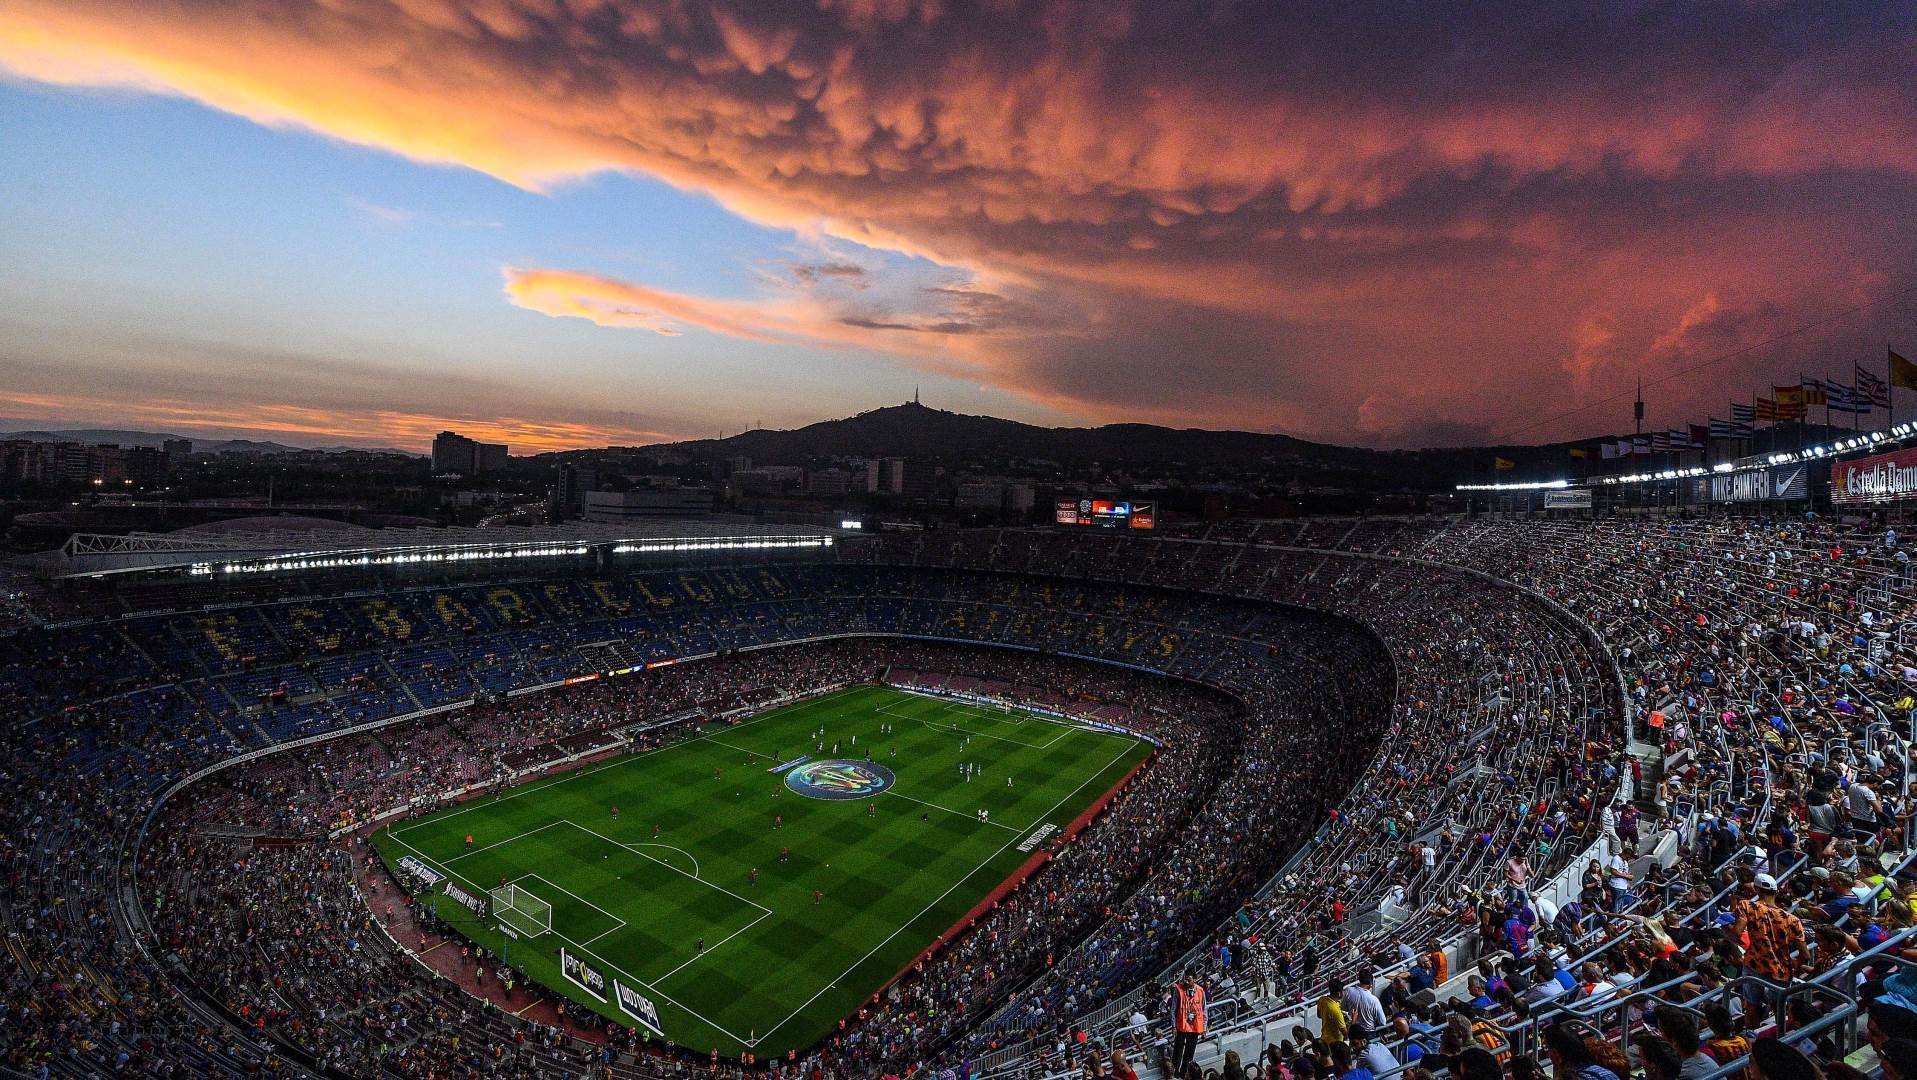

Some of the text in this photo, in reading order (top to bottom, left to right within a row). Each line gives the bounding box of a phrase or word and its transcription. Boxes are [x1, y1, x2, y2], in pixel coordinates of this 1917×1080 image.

[1712, 471, 1769, 501] NIKE.COM/FCB
[1847, 460, 1917, 497] Estrella Dam
[316, 730, 344, 741] KONAMI
[239, 749, 269, 761] KONAMI
